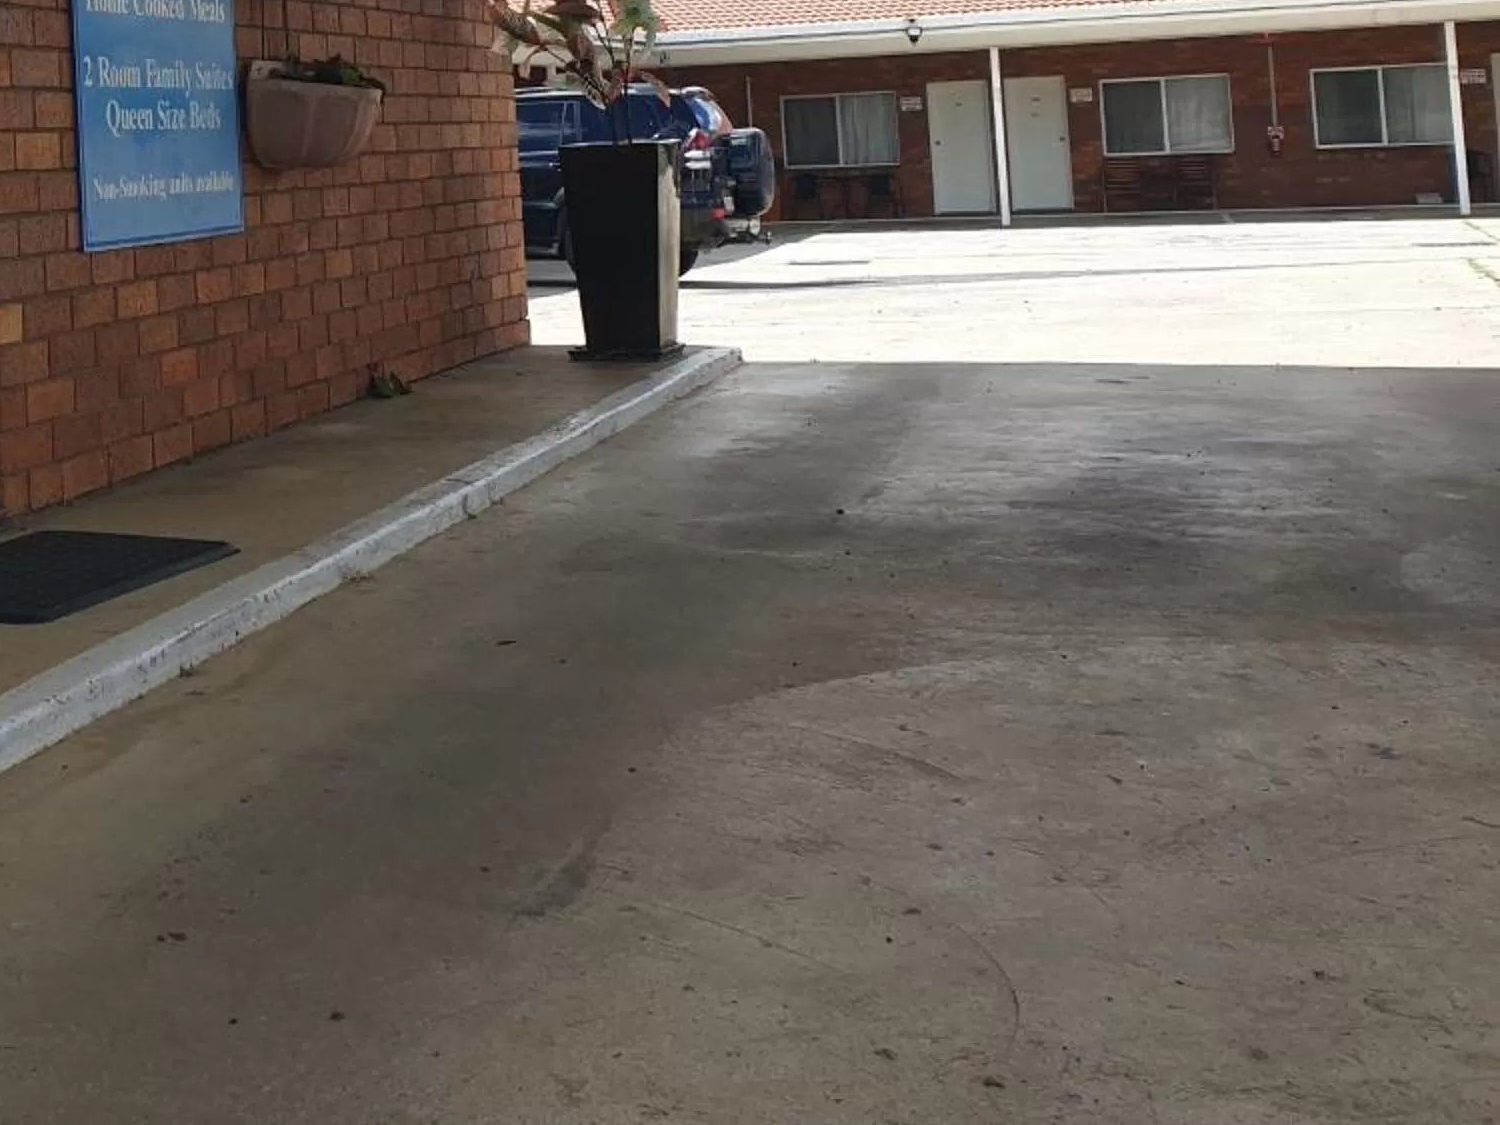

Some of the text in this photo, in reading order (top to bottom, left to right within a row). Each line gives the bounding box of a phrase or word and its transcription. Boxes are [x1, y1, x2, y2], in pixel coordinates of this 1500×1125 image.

[83, 54, 234, 100] 2 Room Family Suites
[105, 98, 222, 138] Queen Size Beds
